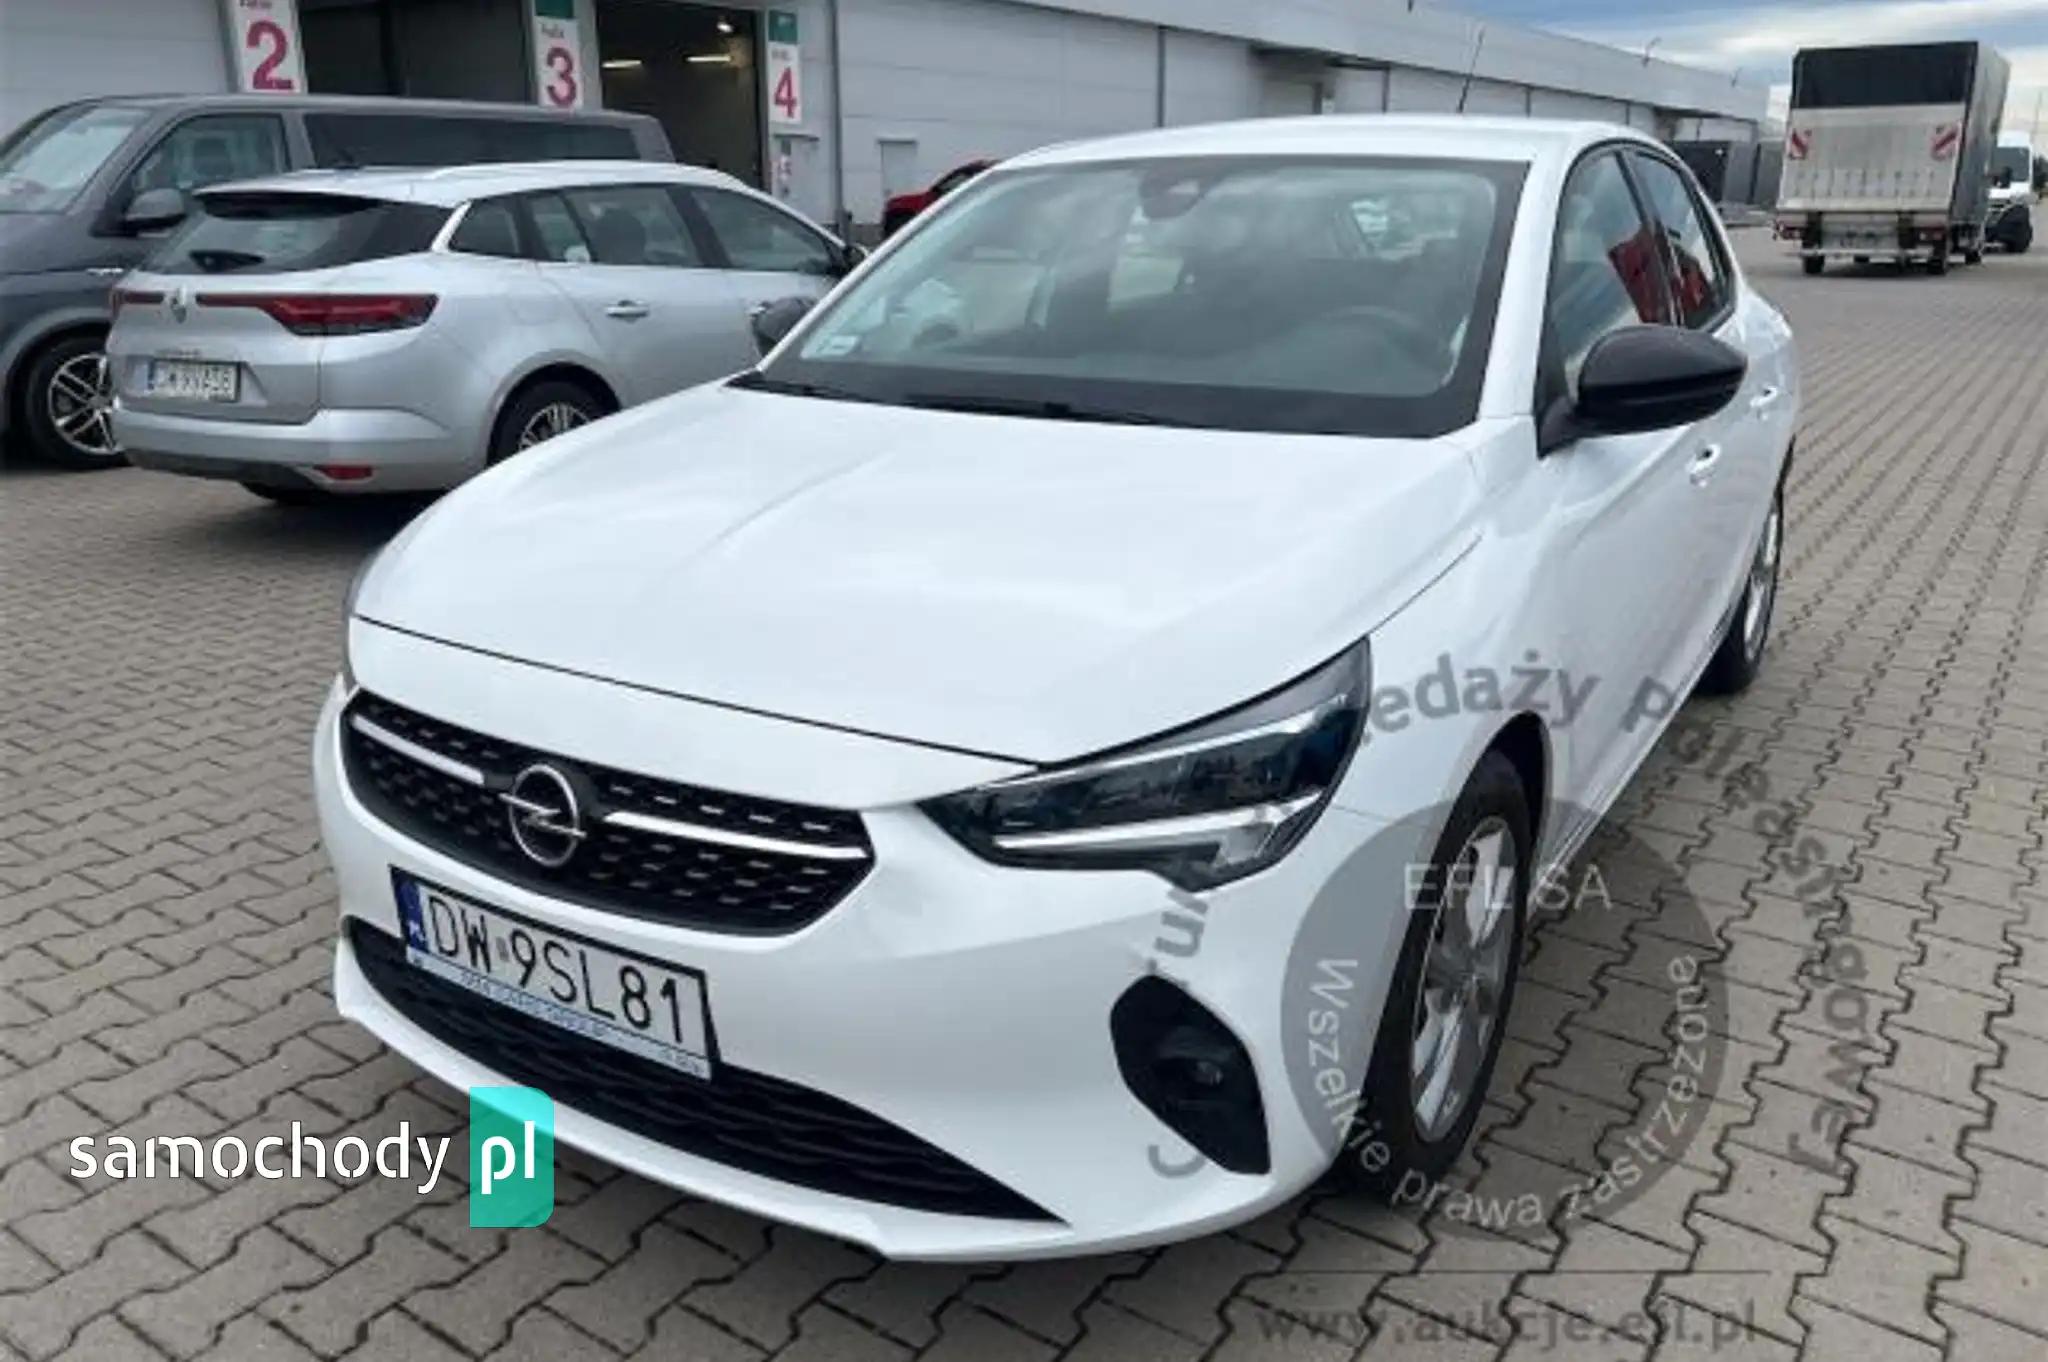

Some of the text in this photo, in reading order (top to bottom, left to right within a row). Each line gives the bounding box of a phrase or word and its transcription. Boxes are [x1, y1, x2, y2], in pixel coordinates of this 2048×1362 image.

[247, 20, 292, 90] 2
[546, 47, 577, 108] 3
[774, 67, 797, 118] 4
[429, 896, 491, 973] DW
[510, 928, 682, 1044] 9SL81
